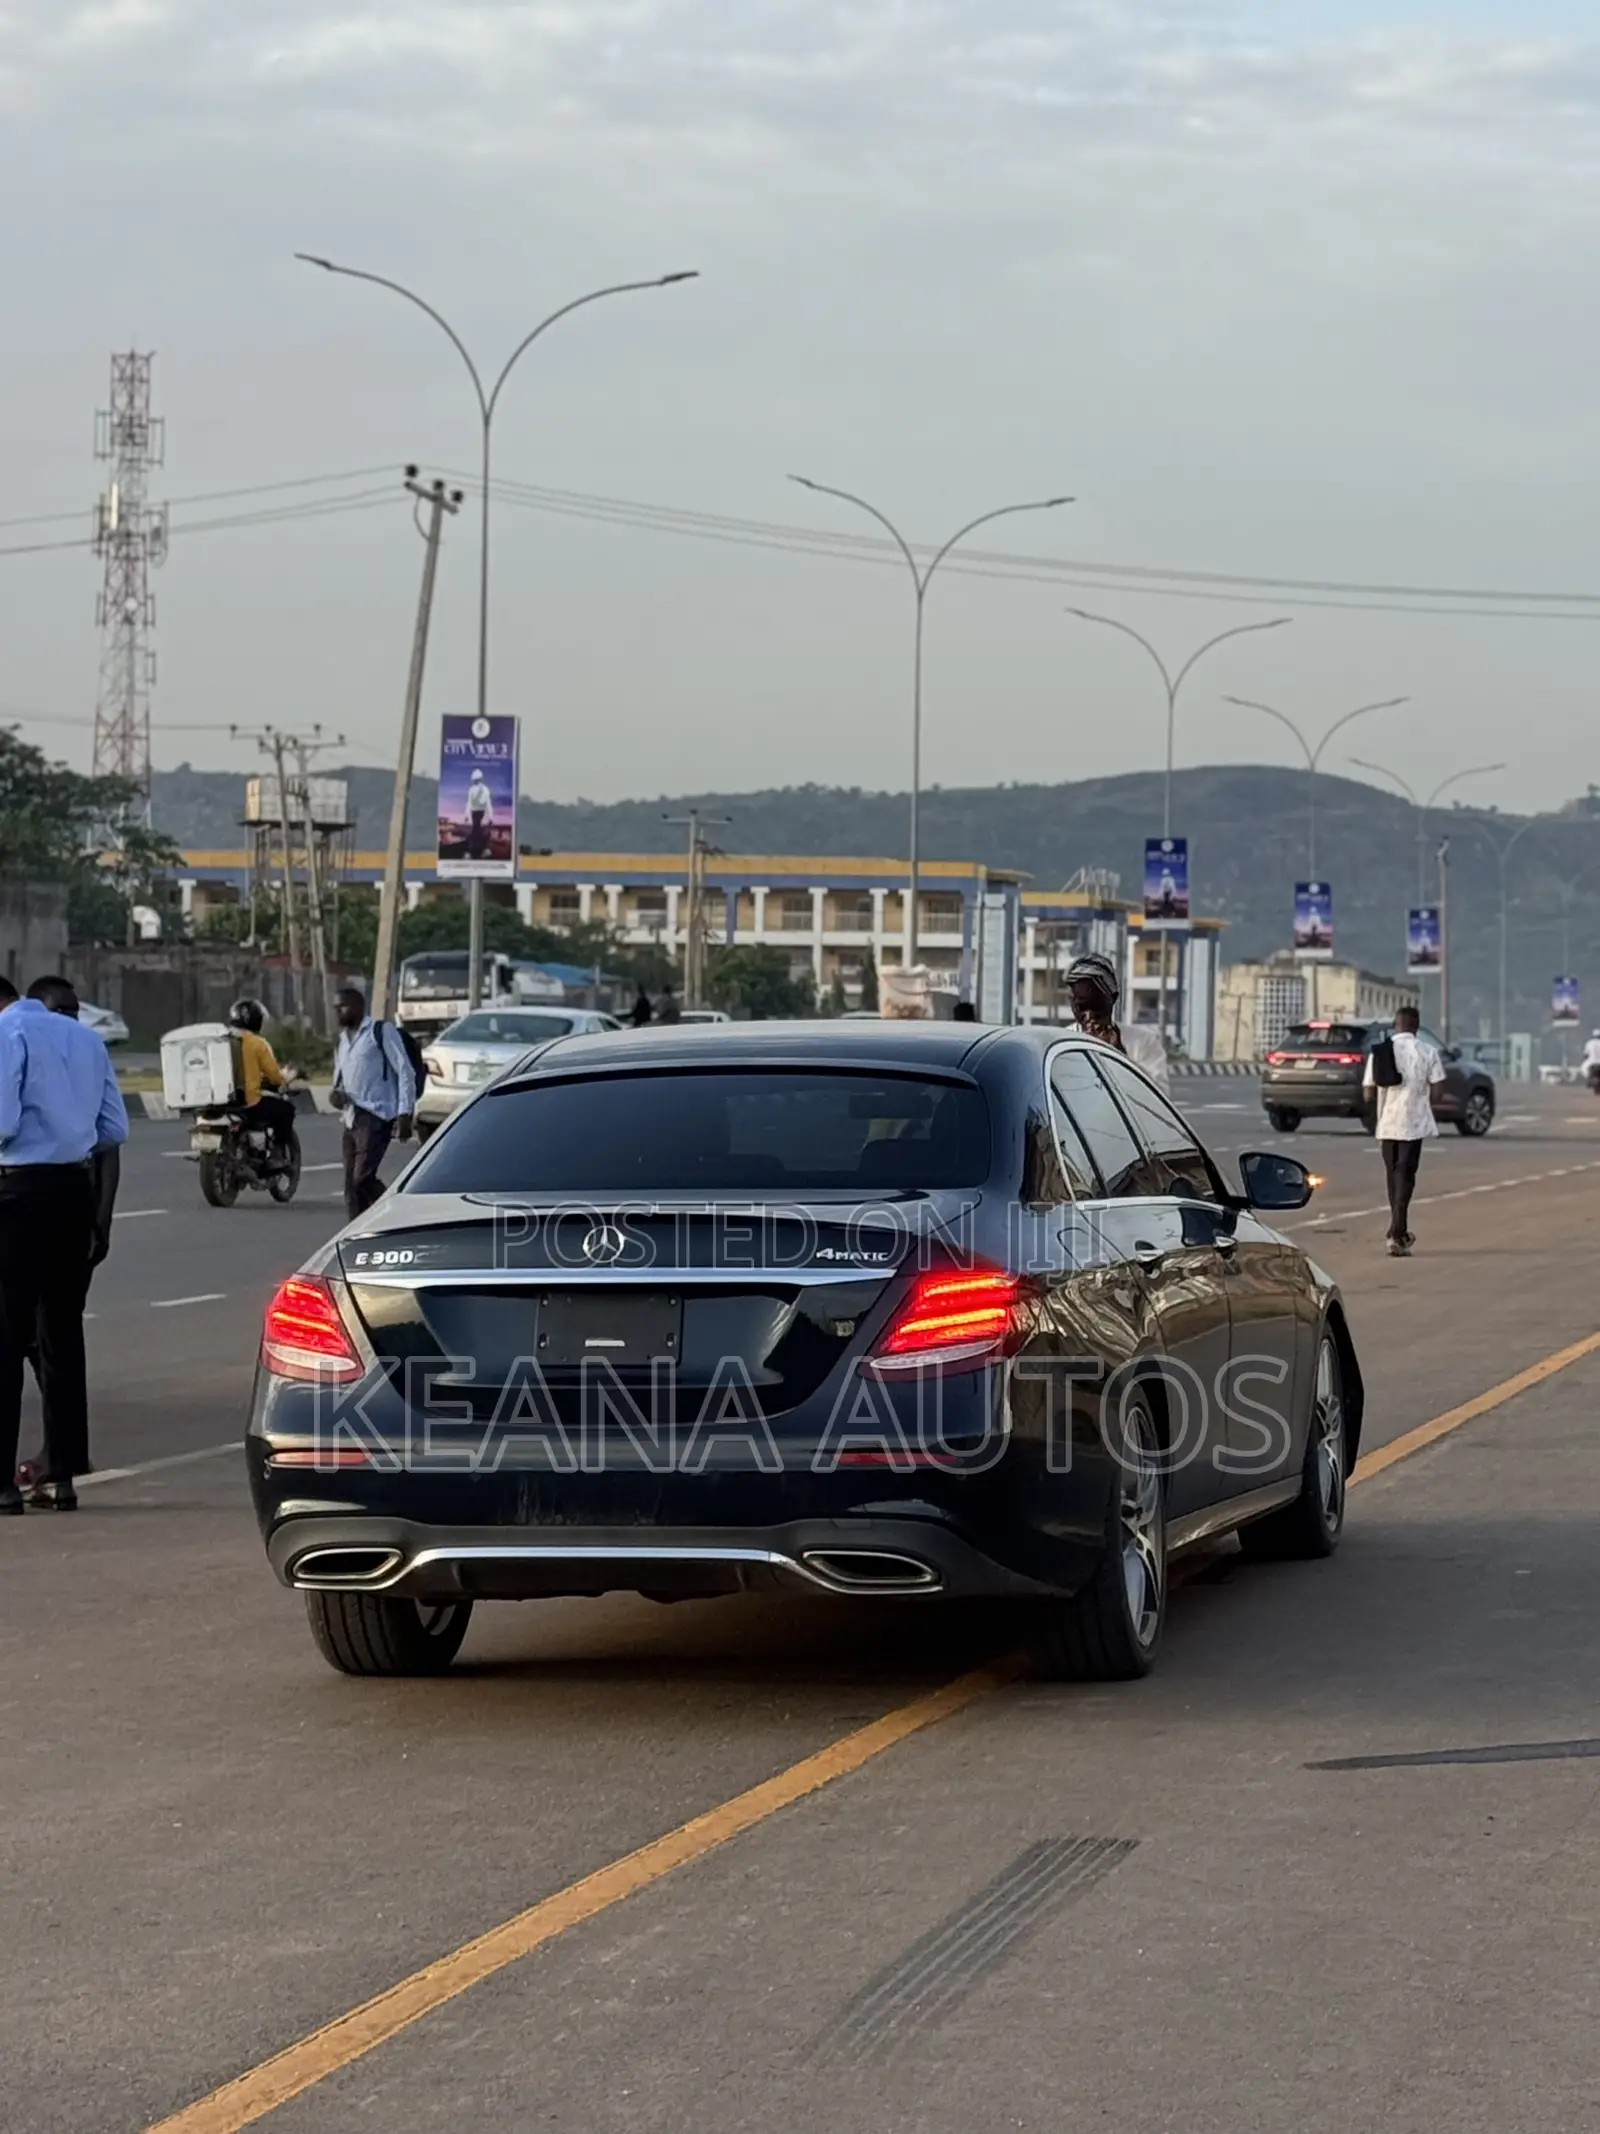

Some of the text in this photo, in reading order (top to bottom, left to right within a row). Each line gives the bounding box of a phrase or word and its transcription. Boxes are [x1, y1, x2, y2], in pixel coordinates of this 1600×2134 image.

[355, 1250, 414, 1266] E 300
[816, 1247, 889, 1261] 4MATIC
